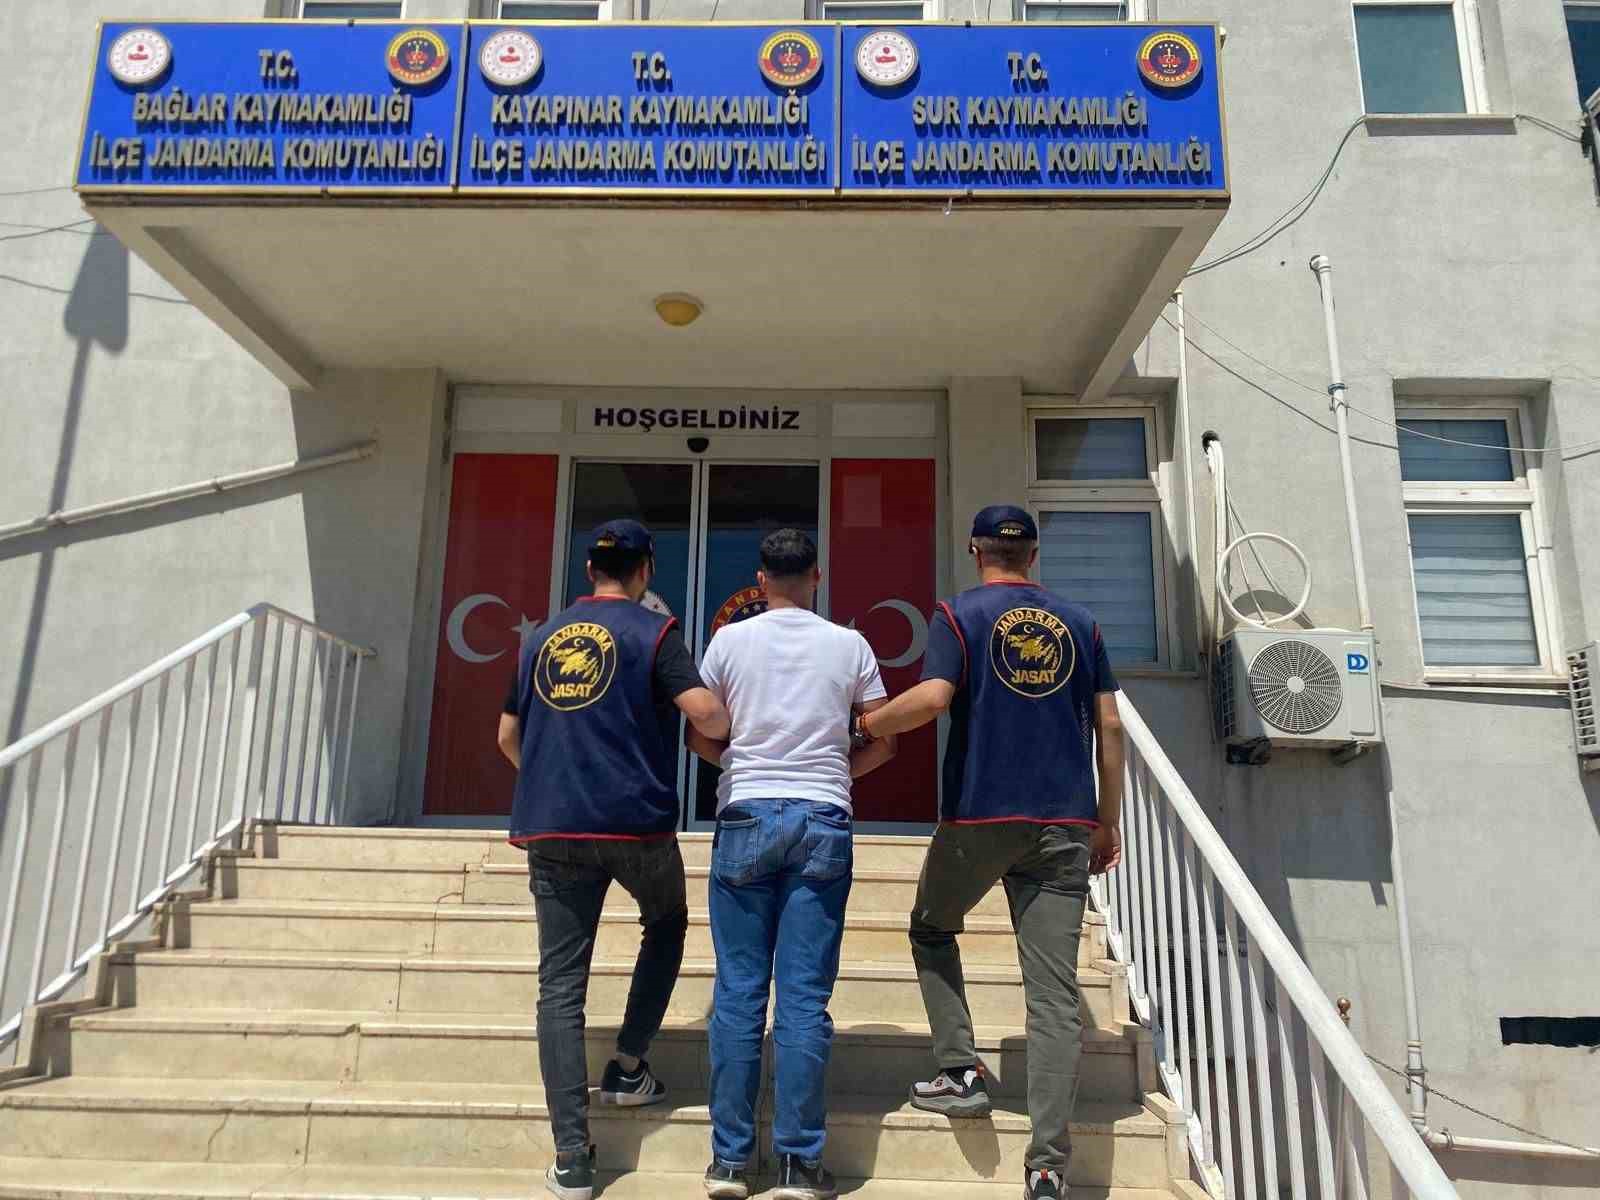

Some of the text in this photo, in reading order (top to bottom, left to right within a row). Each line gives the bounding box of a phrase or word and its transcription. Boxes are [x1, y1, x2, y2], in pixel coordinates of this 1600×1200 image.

[259, 49, 297, 77] T.C.
[632, 51, 672, 79] T.C.
[1007, 52, 1048, 80] T.C.
[133, 86, 411, 122] BAĞLAR KAYMAKAMLIĞI
[491, 89, 808, 124] KAYAPINAR KAYMAKAMLIĞI
[912, 91, 1147, 125] SUR KAYMAKAMLIĞI
[90, 130, 444, 168] İLÇE JANDARMA KOMUTANLIĞI
[470, 133, 826, 171] İLÇE JANDARMA KOMUTANLIĞI
[852, 134, 1212, 173] İLÇE JANDARMA KOMUTANLIĞI
[594, 405, 801, 433] HOŞGELDİNİZ
[997, 610, 1066, 639] JANDARMA
[548, 625, 612, 653] JANDARMA
[549, 682, 594, 699] JASAT
[1010, 669, 1058, 684] JASAT
